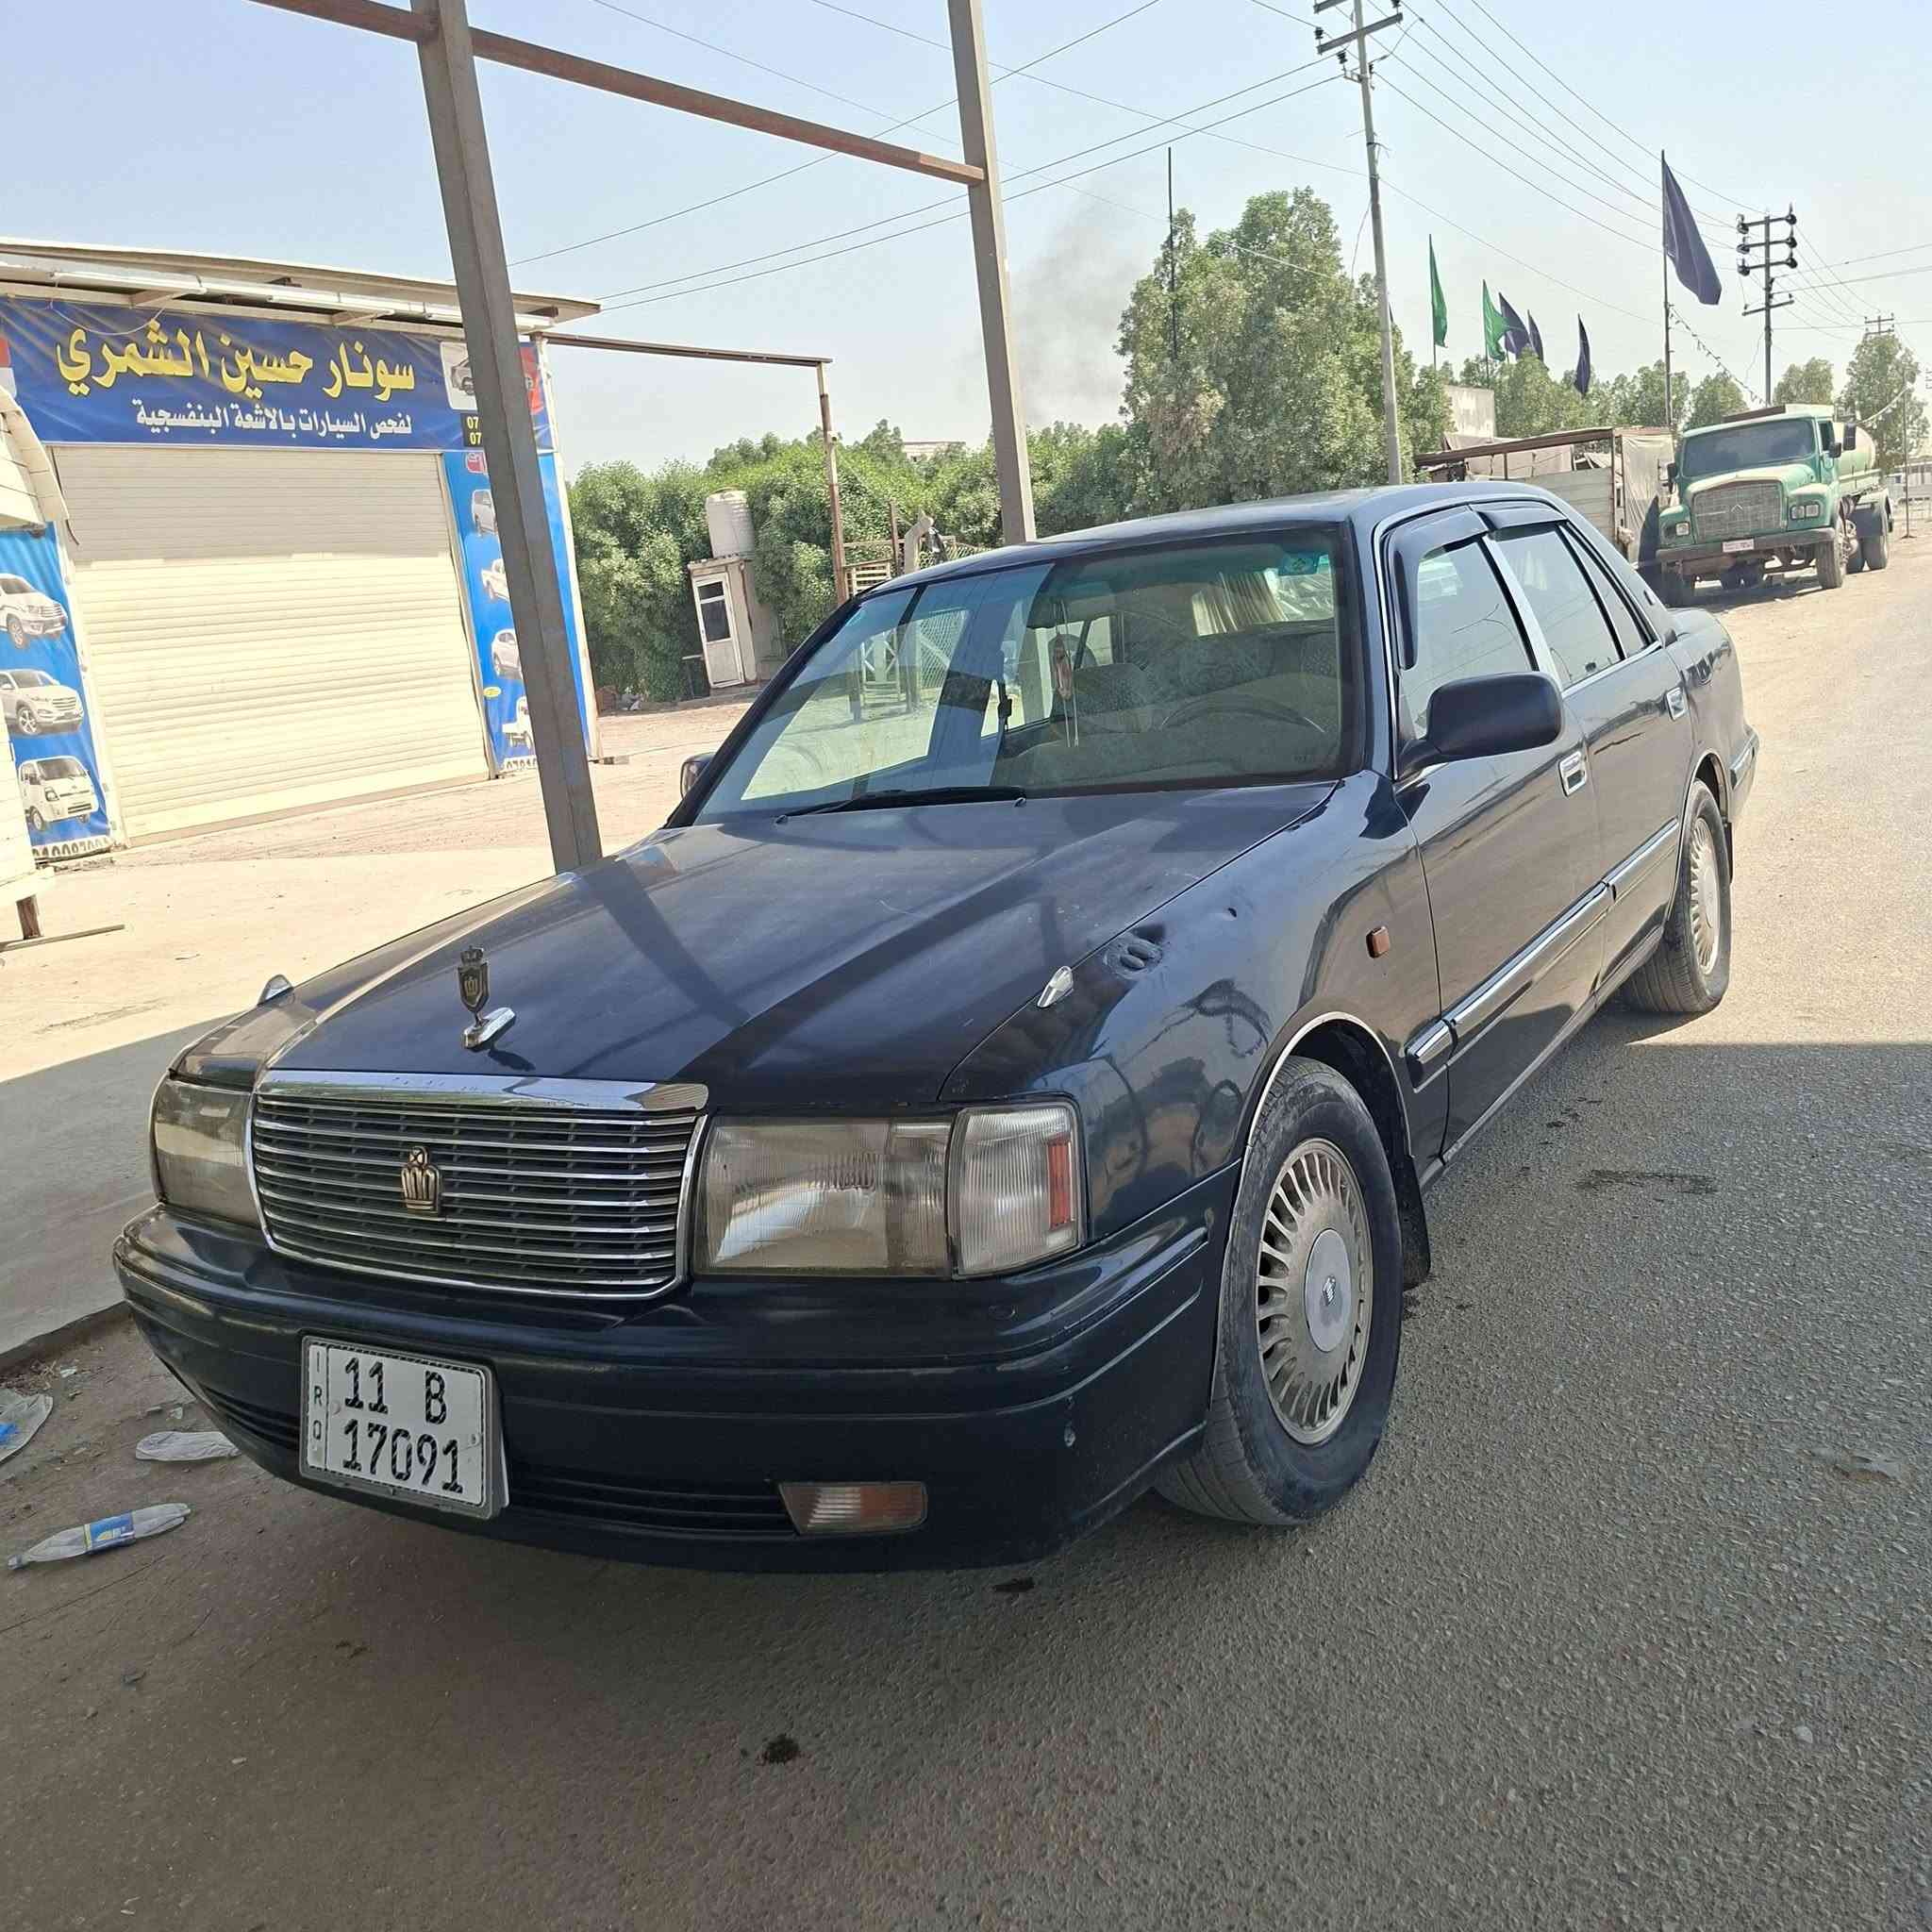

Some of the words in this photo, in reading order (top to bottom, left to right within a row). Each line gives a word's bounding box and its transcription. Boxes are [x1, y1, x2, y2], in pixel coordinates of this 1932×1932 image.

[57, 319, 210, 396] الشمري
[220, 333, 314, 399] حسين
[322, 341, 415, 402] سونار
[131, 399, 229, 434] البنفسجية
[299, 408, 367, 439] السيارات
[369, 412, 413, 440] لفحص
[344, 1357, 389, 1415] 11
[425, 1370, 447, 1425] B
[342, 1419, 463, 1493] 17091
